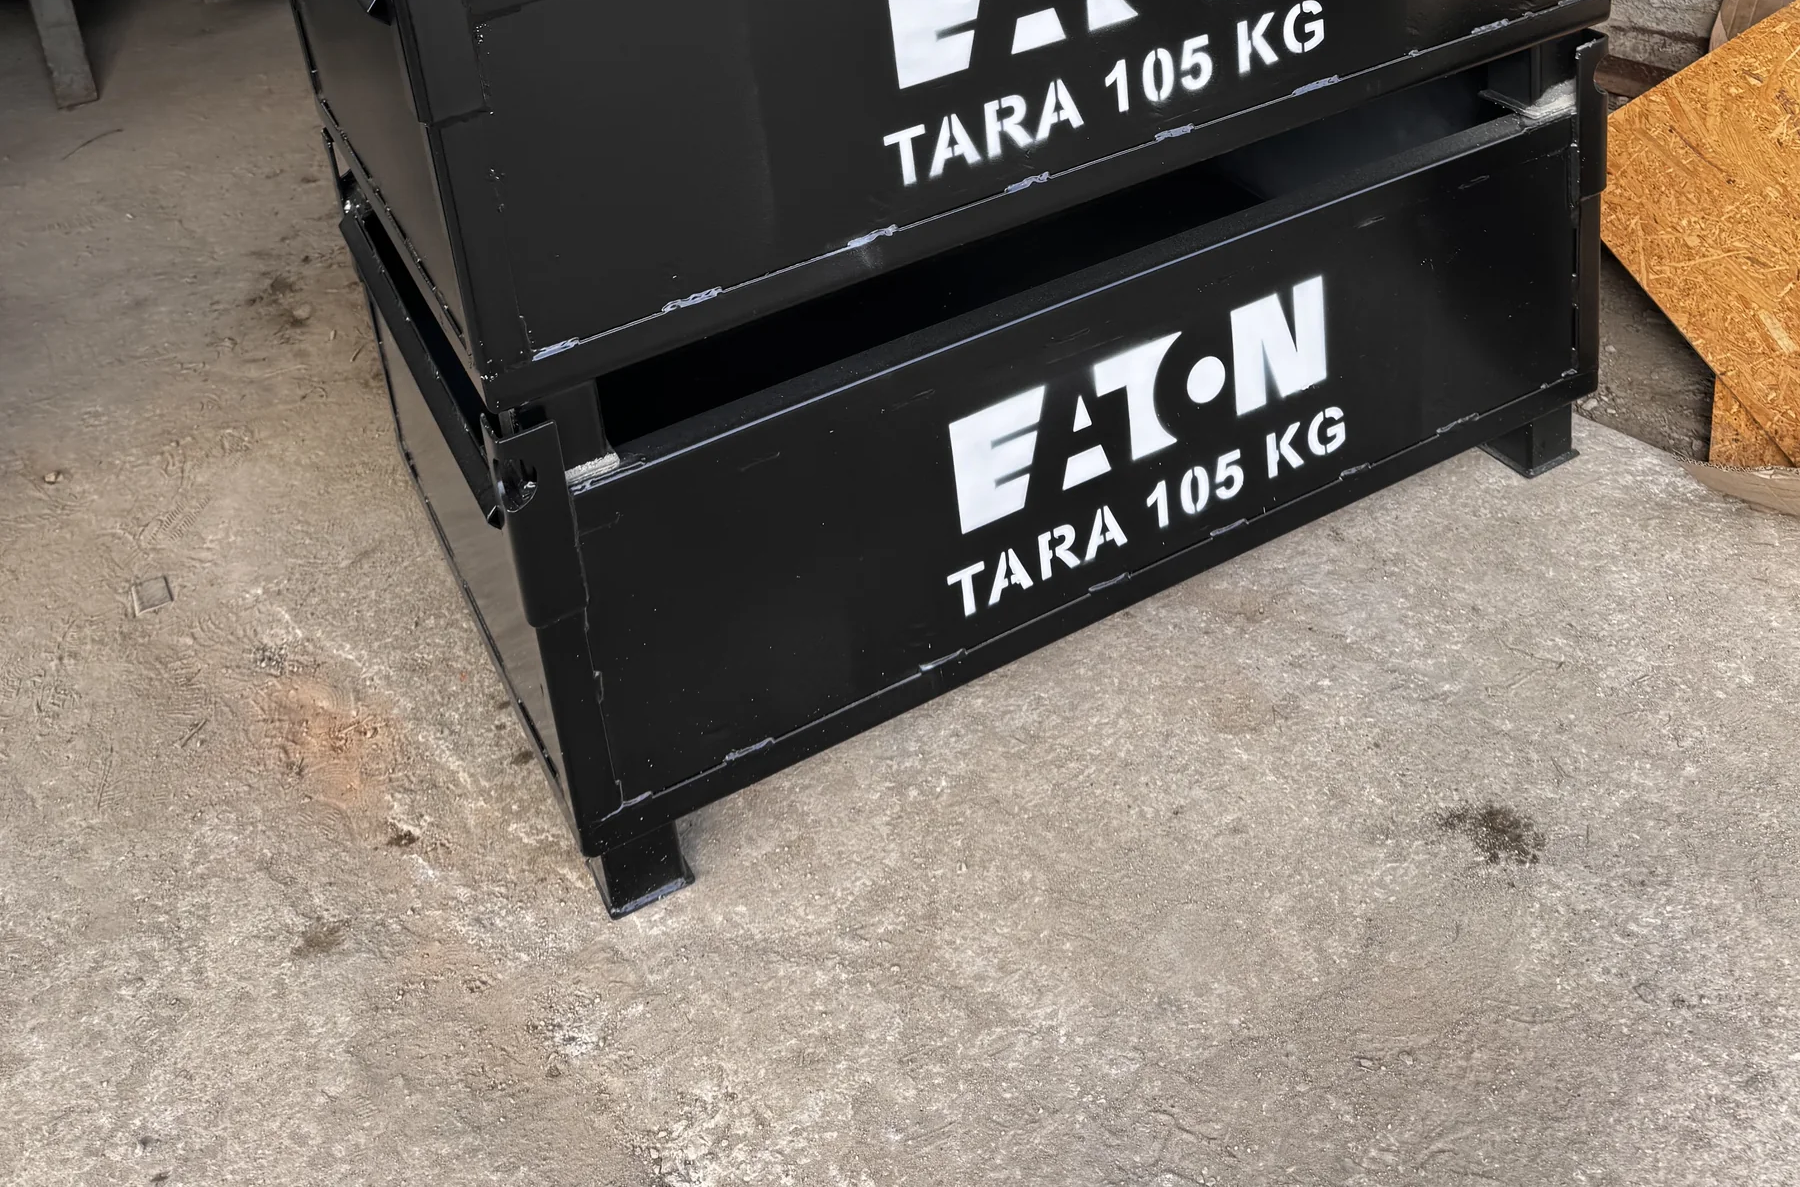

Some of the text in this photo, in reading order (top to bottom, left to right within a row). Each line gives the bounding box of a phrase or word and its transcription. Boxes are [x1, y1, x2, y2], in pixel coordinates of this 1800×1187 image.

[882, 0, 1326, 186] TARA 105 KG
[948, 274, 1328, 535] EATON
[946, 406, 1346, 617] TARA 105 KG
